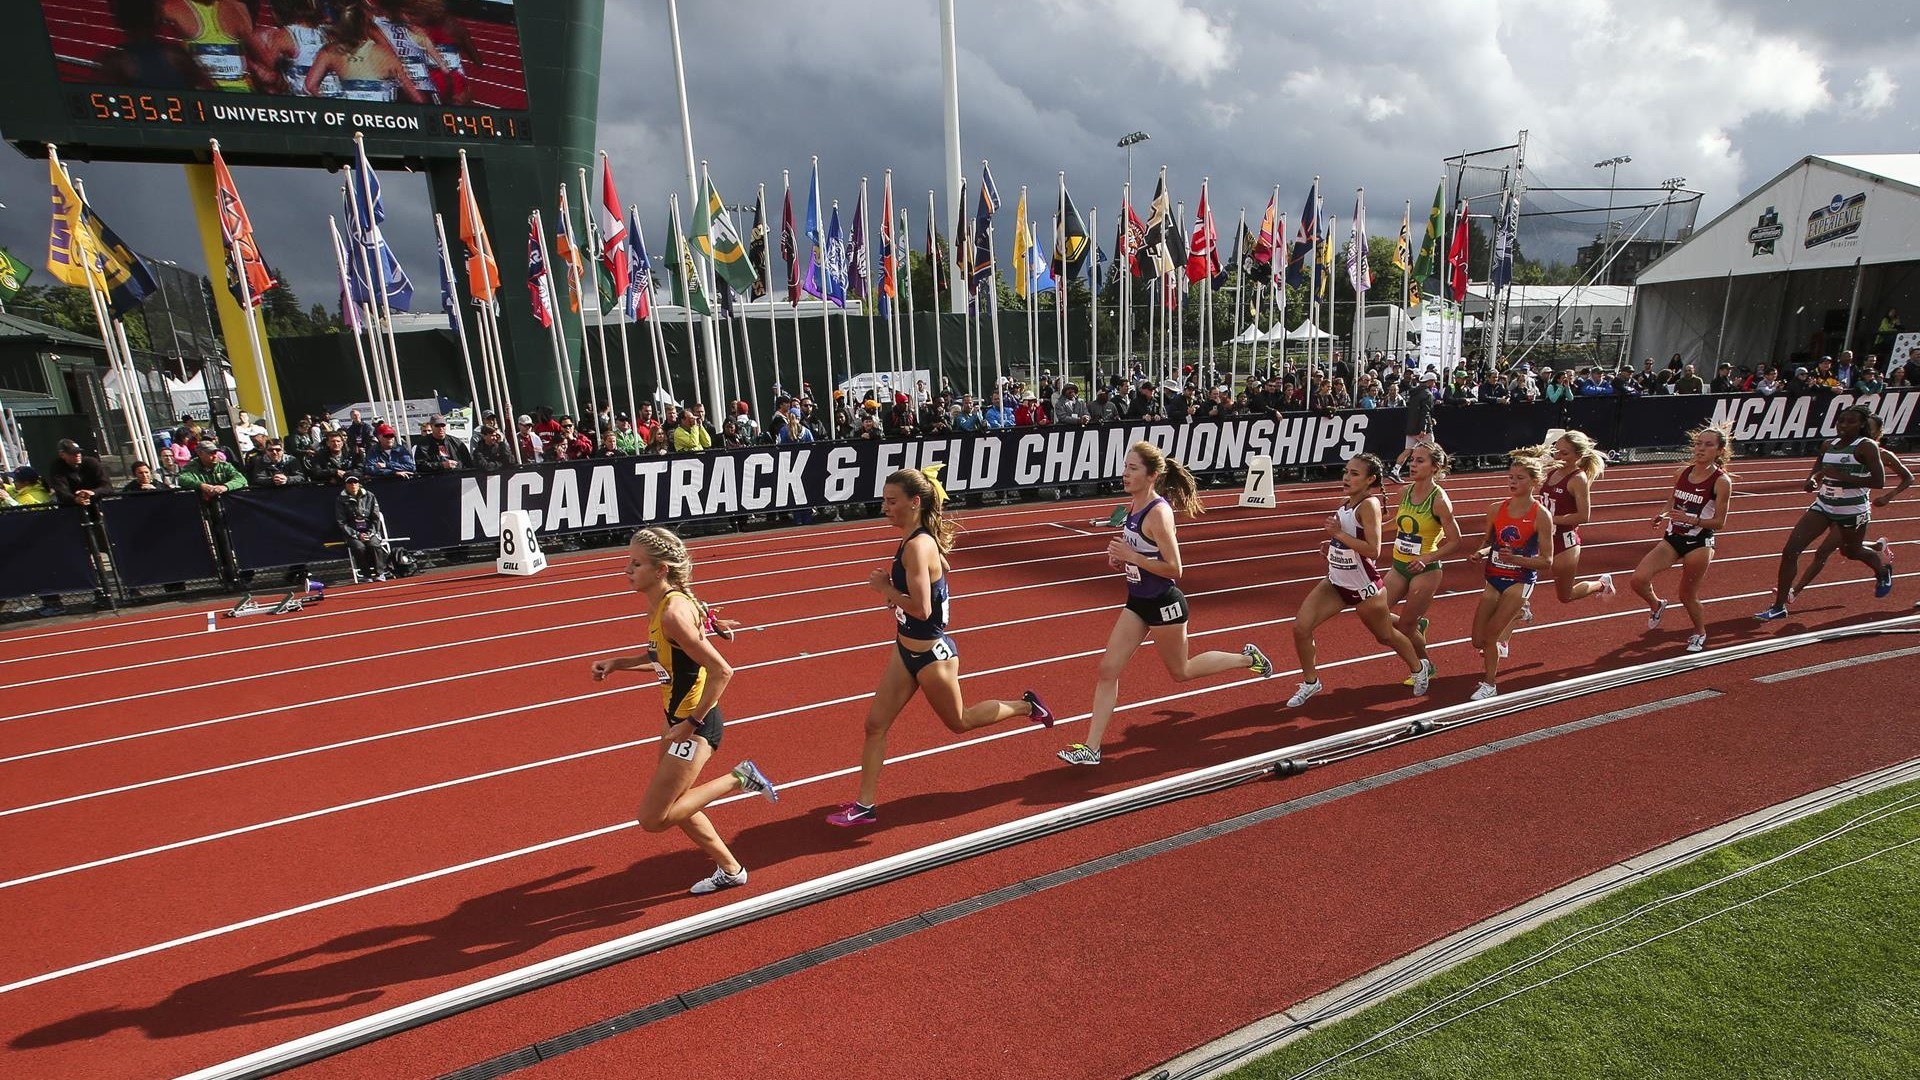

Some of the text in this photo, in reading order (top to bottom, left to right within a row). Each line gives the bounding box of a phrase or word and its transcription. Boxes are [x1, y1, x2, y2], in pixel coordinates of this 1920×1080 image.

[212, 105, 419, 130] UNIVERSITY OF OREGON
[443, 111, 516, 138] 9:49.1
[1807, 205, 1863, 238] EXPERIENCE
[460, 465, 620, 541] NCAA
[635, 450, 811, 521] TRACK
[824, 446, 860, 502] &
[1014, 414, 1369, 486] CHAMPIONSHIPS
[1251, 470, 1265, 491] 7
[1247, 496, 1265, 504] GILL
[503, 528, 515, 555] 8
[526, 527, 536, 553] 8
[503, 562, 519, 571] GILL
[1361, 584, 1376, 599] 20
[1164, 605, 1181, 620] 11
[935, 643, 949, 660] 3
[674, 739, 693, 758] 13
